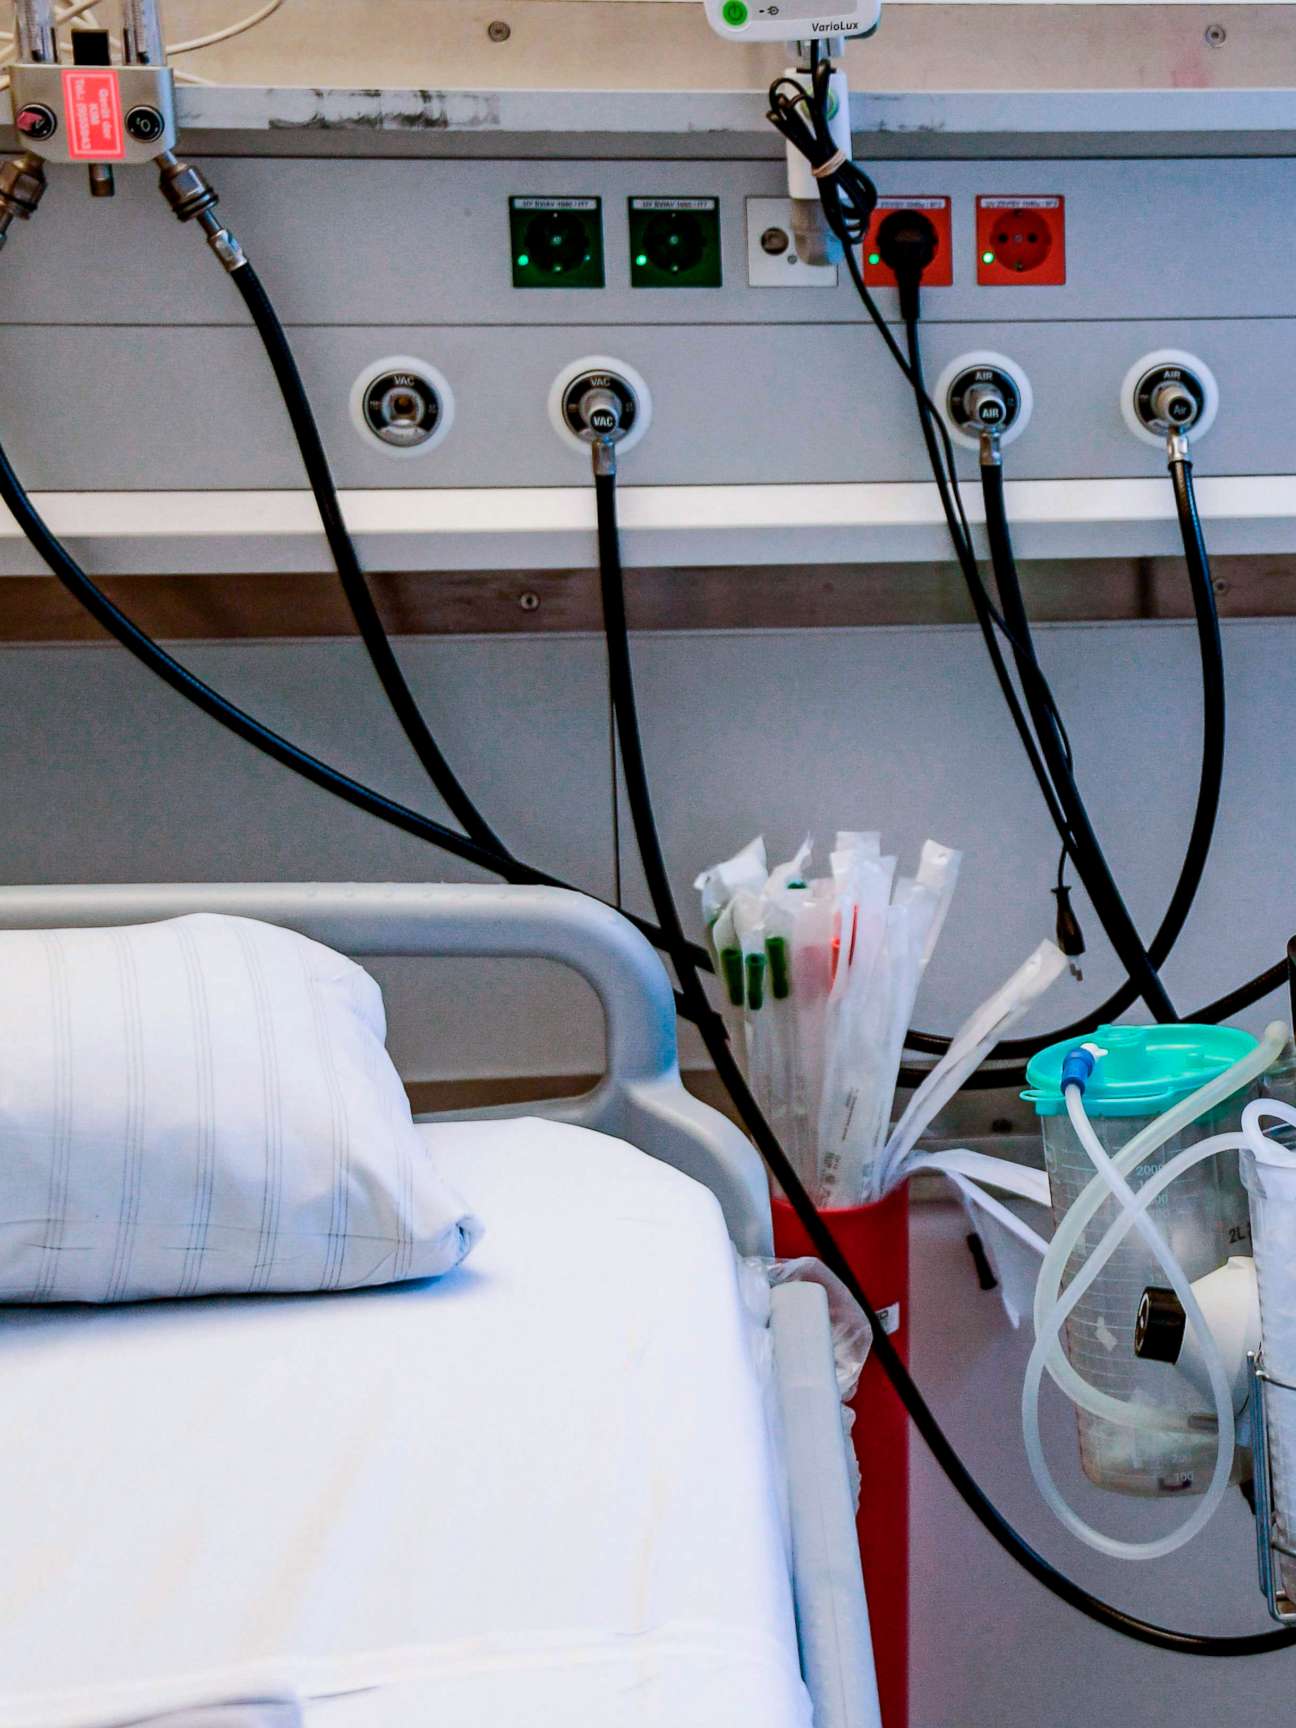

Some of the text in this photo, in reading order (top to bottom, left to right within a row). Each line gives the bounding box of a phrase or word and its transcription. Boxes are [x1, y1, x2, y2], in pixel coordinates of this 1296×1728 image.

[811, 21, 858, 32] VarioLux
[975, 371, 993, 381] AIR
[1163, 370, 1181, 379] AIR
[394, 375, 415, 386] VAC
[590, 376, 611, 388] VAC
[982, 408, 999, 419] AIR
[593, 415, 613, 427] VAC
